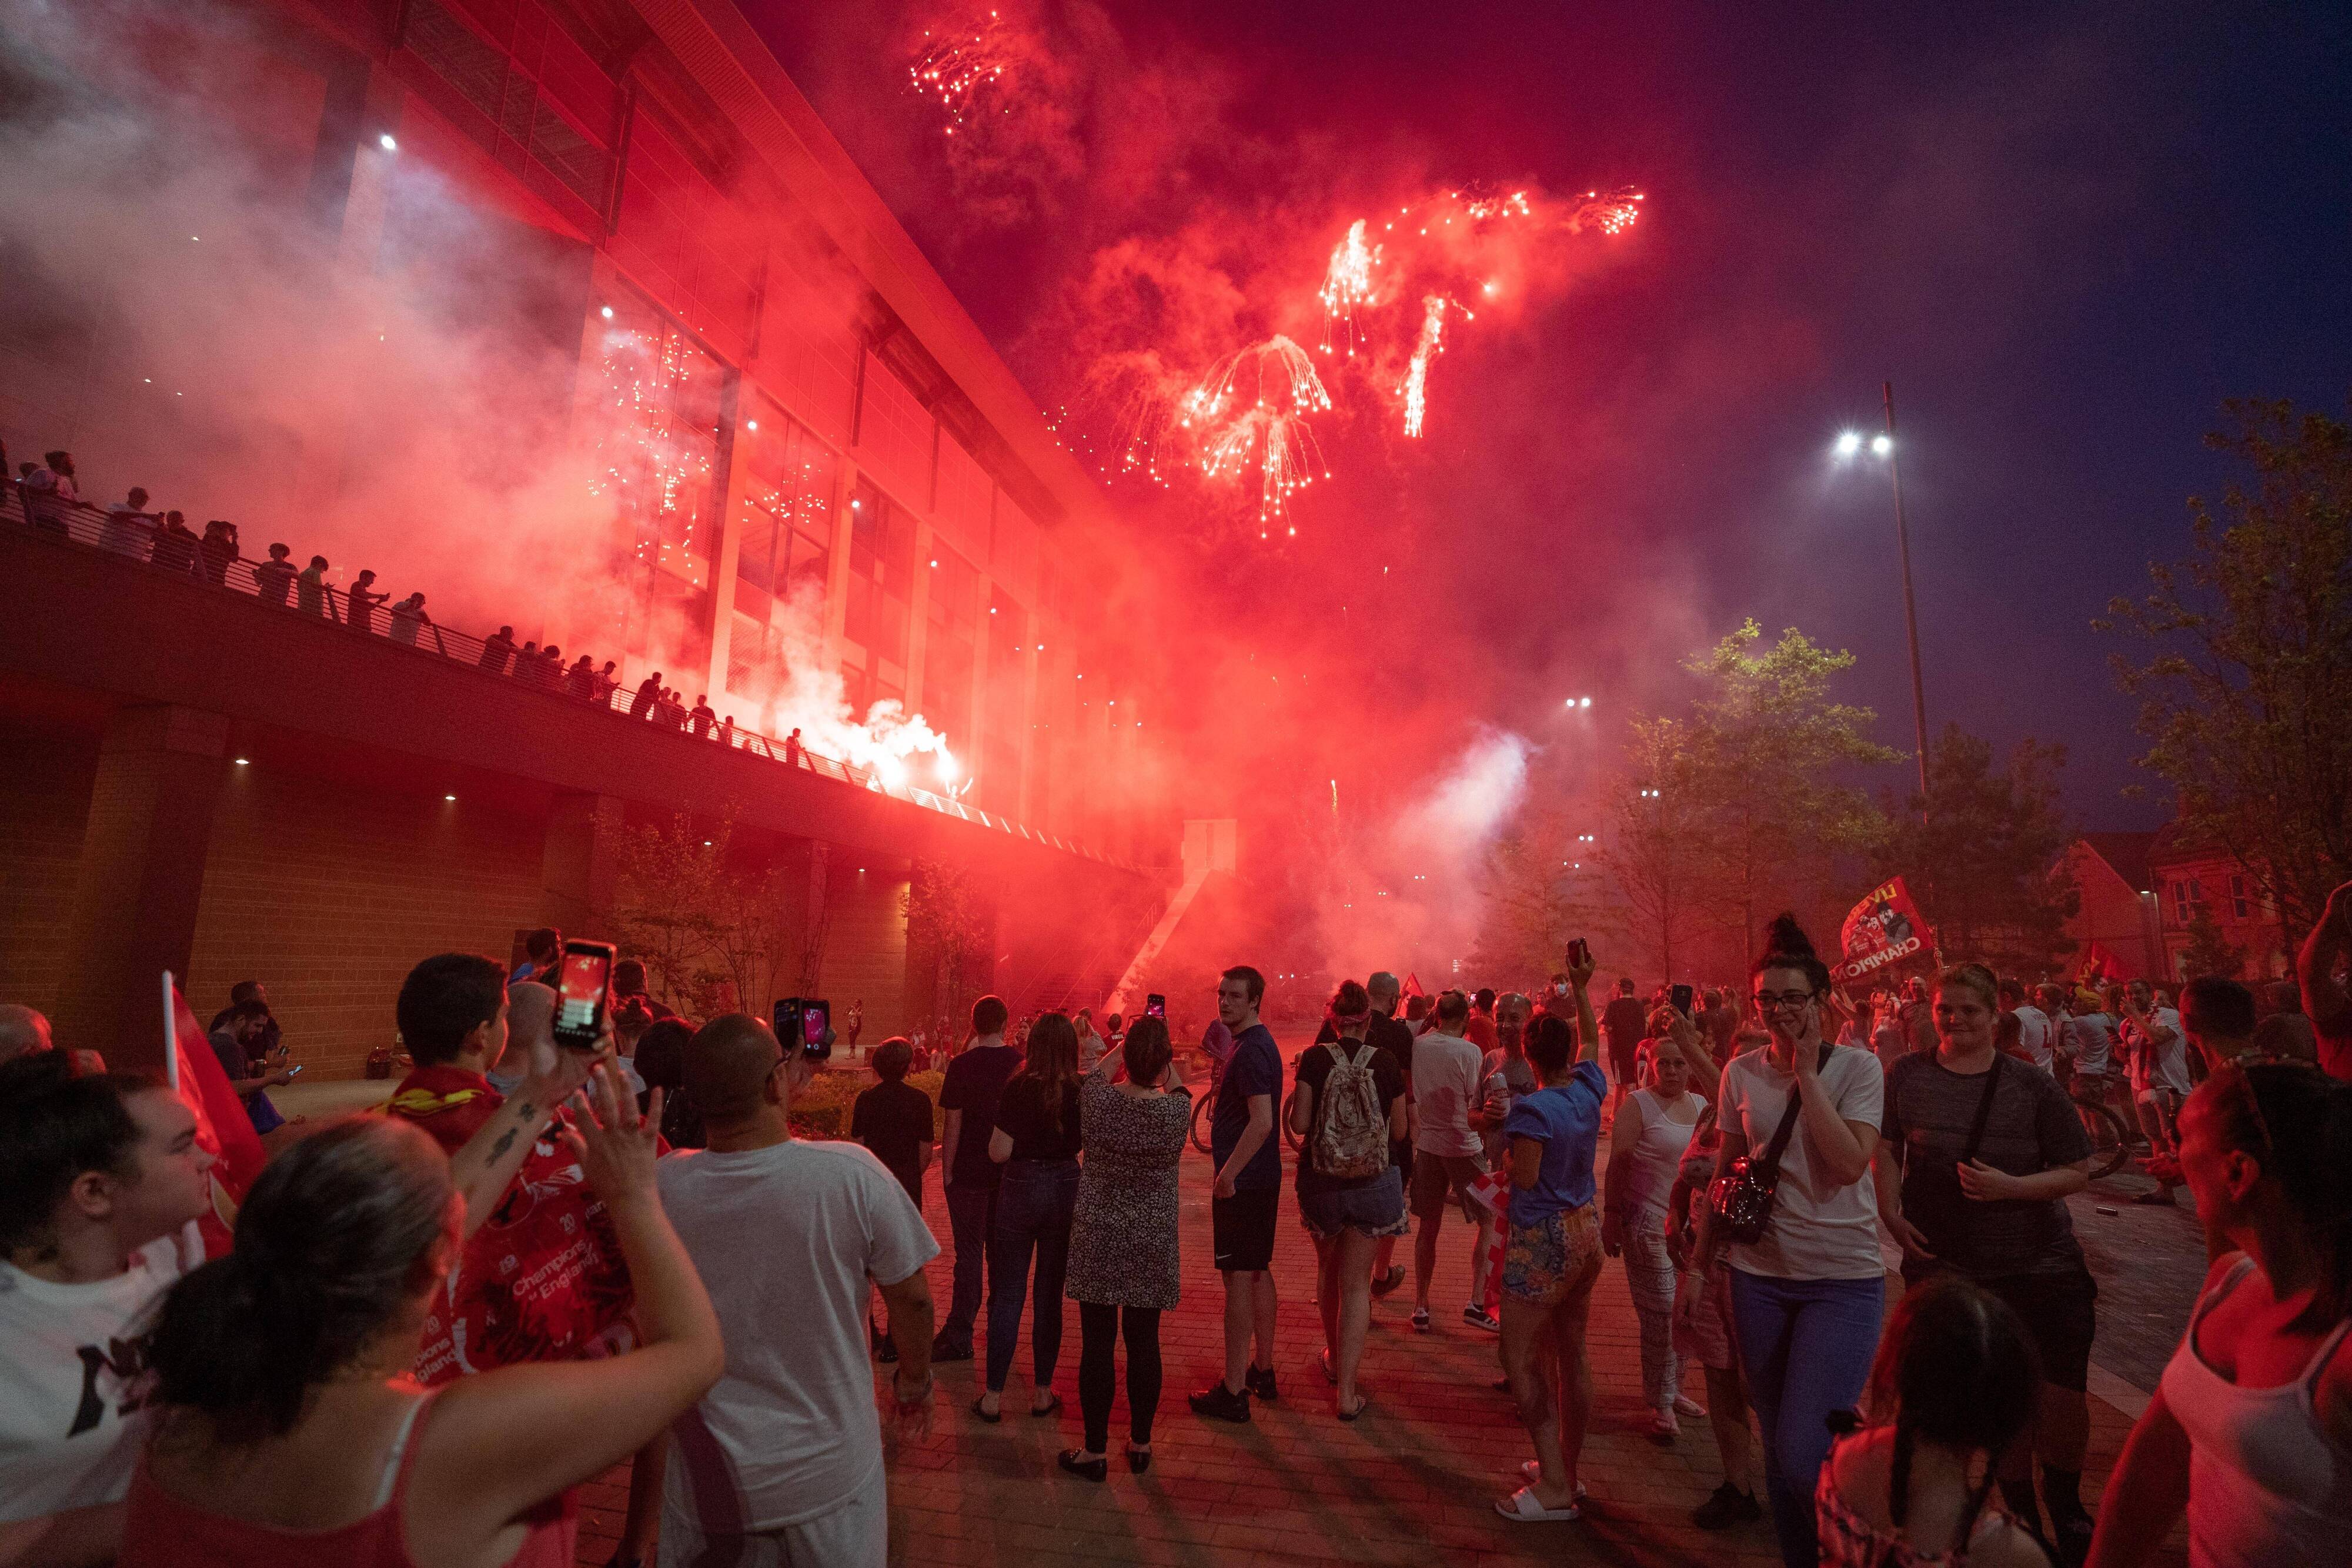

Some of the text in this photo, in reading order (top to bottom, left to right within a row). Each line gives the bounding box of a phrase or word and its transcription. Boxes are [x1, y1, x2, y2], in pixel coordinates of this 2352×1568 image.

[512, 1239, 587, 1296] Champions
[539, 1242, 600, 1300] England
[415, 1338, 452, 1368] pions
[416, 1348, 457, 1383] gland
